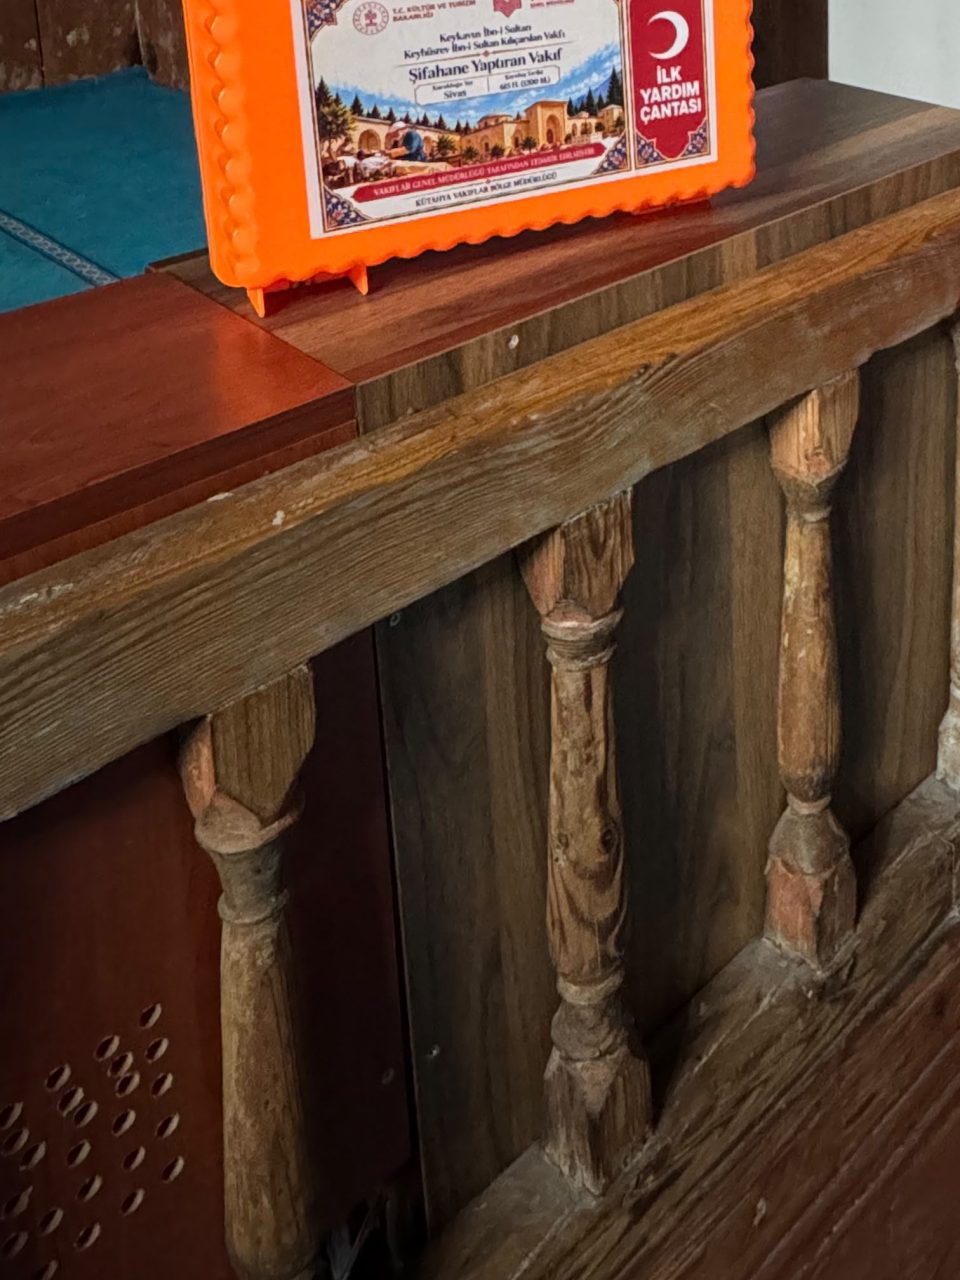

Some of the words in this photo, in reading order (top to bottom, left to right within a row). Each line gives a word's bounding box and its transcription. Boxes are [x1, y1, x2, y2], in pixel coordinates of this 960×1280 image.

[409, 64, 469, 84] Şifahane
[471, 56, 526, 74] Yaptıran
[528, 48, 562, 62] Vakıf
[657, 66, 682, 84] İLK
[640, 81, 699, 104] YARDIM
[640, 98, 701, 125] ÇANTASI
[373, 184, 411, 196] VAKIFLAR
[412, 177, 436, 189] GENEL
